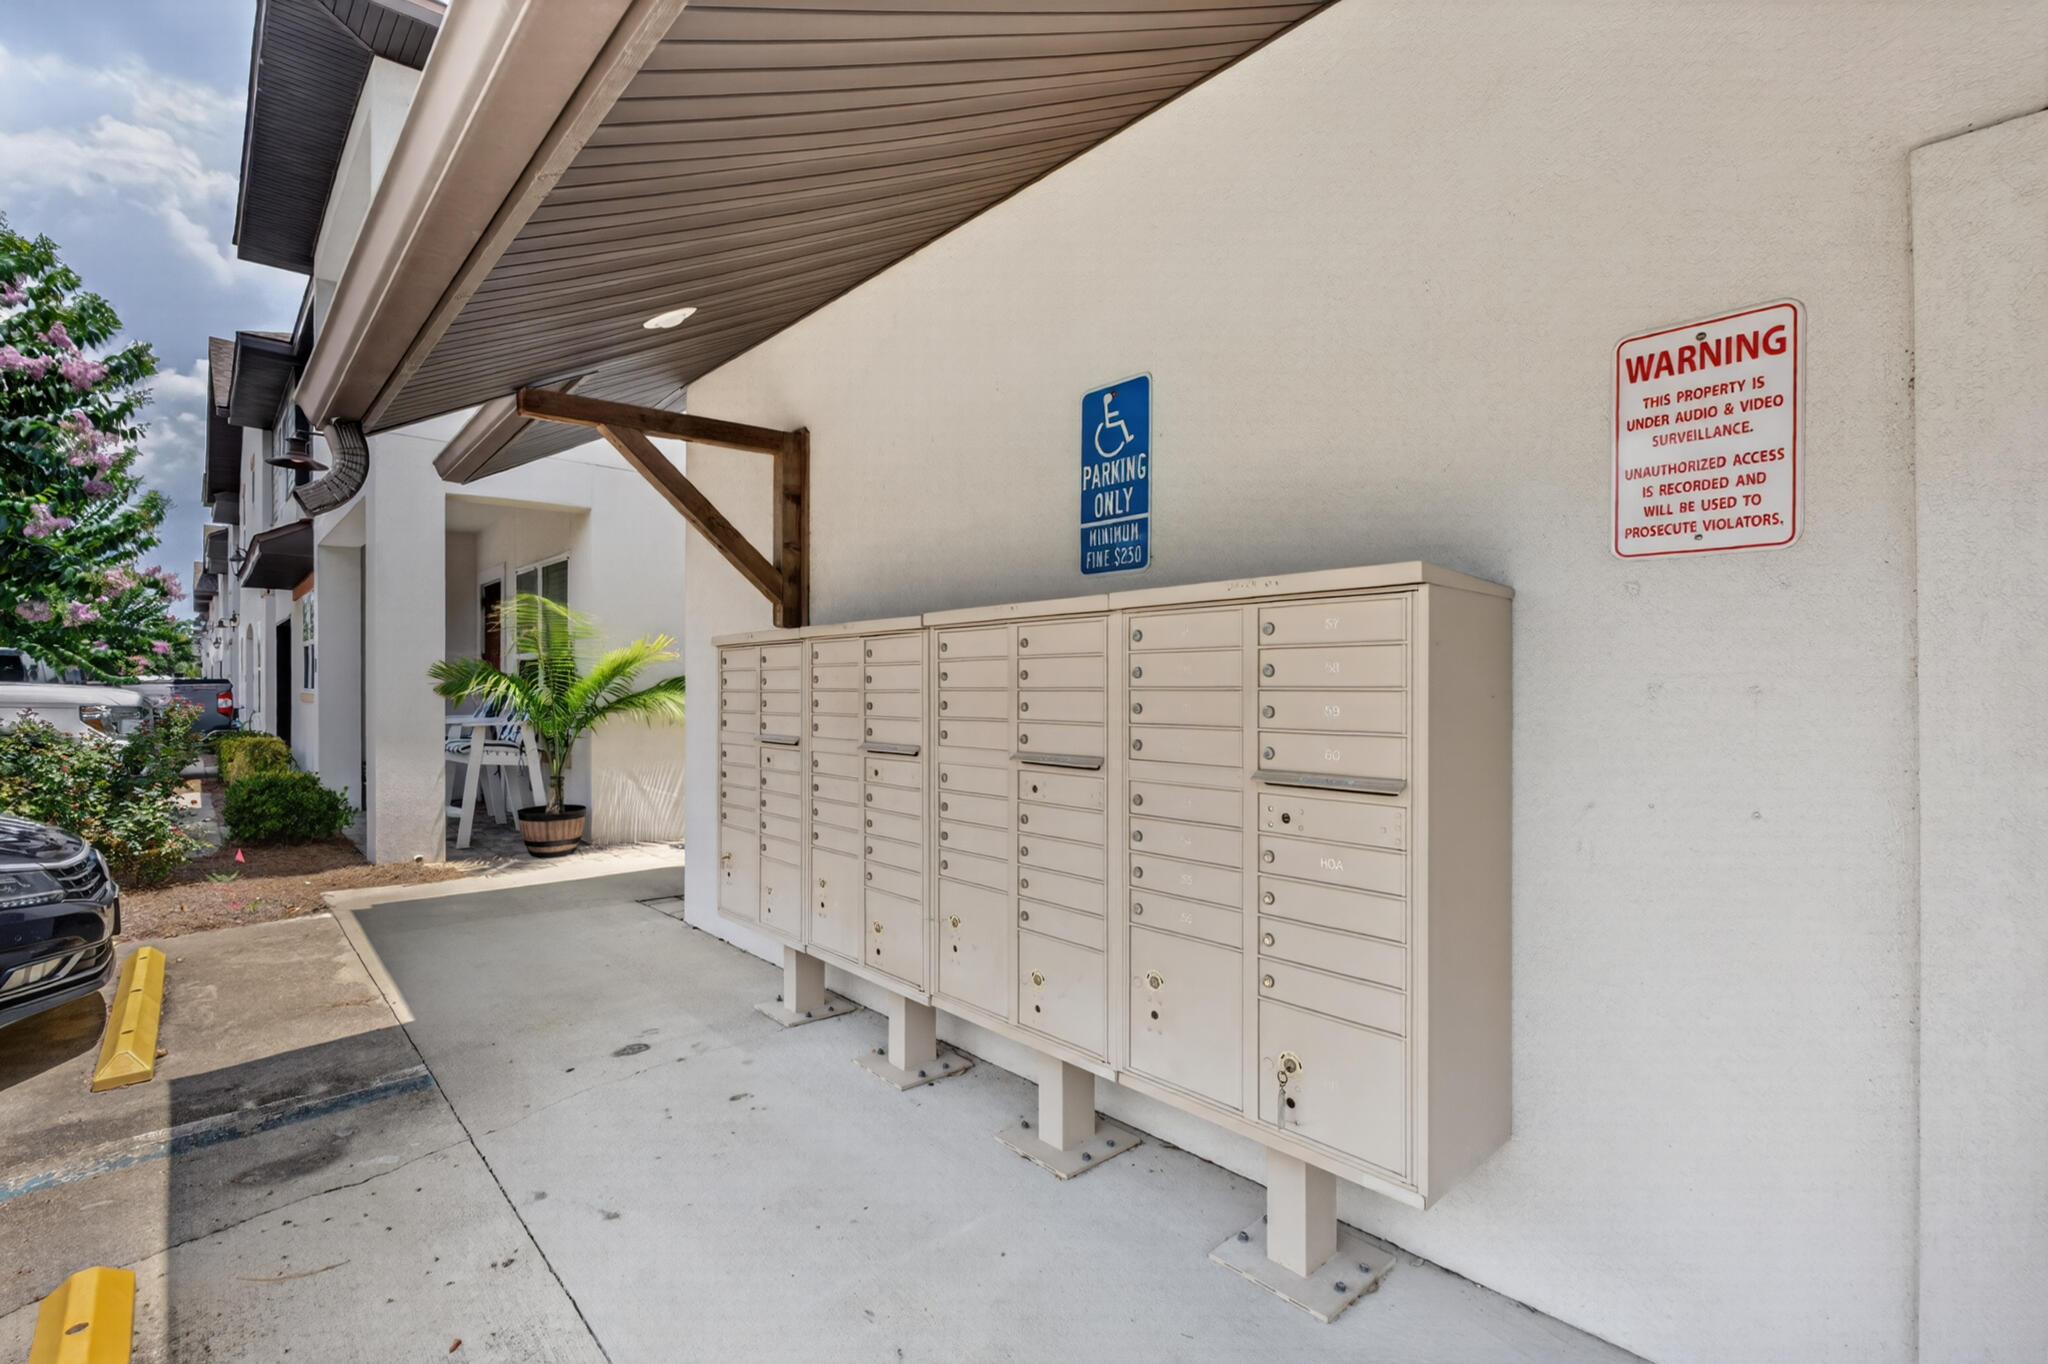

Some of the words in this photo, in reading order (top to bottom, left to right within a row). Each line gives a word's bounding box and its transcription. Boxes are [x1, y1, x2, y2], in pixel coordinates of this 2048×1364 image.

[1625, 324, 1787, 384] WARNING
[1643, 393, 1671, 409] THIS
[1676, 379, 1746, 403] PROPERTY
[1752, 375, 1766, 389] IS
[1626, 414, 1670, 432] UNDER
[1675, 405, 1718, 424] AUDIO
[1723, 402, 1734, 416] &
[1740, 394, 1784, 413] VIDEO
[1652, 420, 1754, 447] SURVEILLANCE.
[1083, 453, 1147, 491] PARKING
[1625, 455, 1727, 481] UNAUTHORIZED
[1733, 447, 1785, 467] ACCESS
[1642, 485, 1654, 498] IS
[1659, 475, 1729, 496] RECORDED
[1735, 471, 1767, 487] AND
[1094, 486, 1134, 518] ONLY
[1643, 504, 1673, 518] WILL
[1679, 500, 1695, 513] BE
[1701, 496, 1737, 512] USED
[1743, 493, 1762, 507] TO
[1089, 522, 1139, 547] MINIMUM
[1625, 521, 1697, 539] PROSECUTE
[1702, 512, 1784, 532] VIOLATORS.
[1086, 549, 1110, 569] FINE
[1114, 545, 1142, 567] $250
[1320, 857, 1344, 872] HOA
